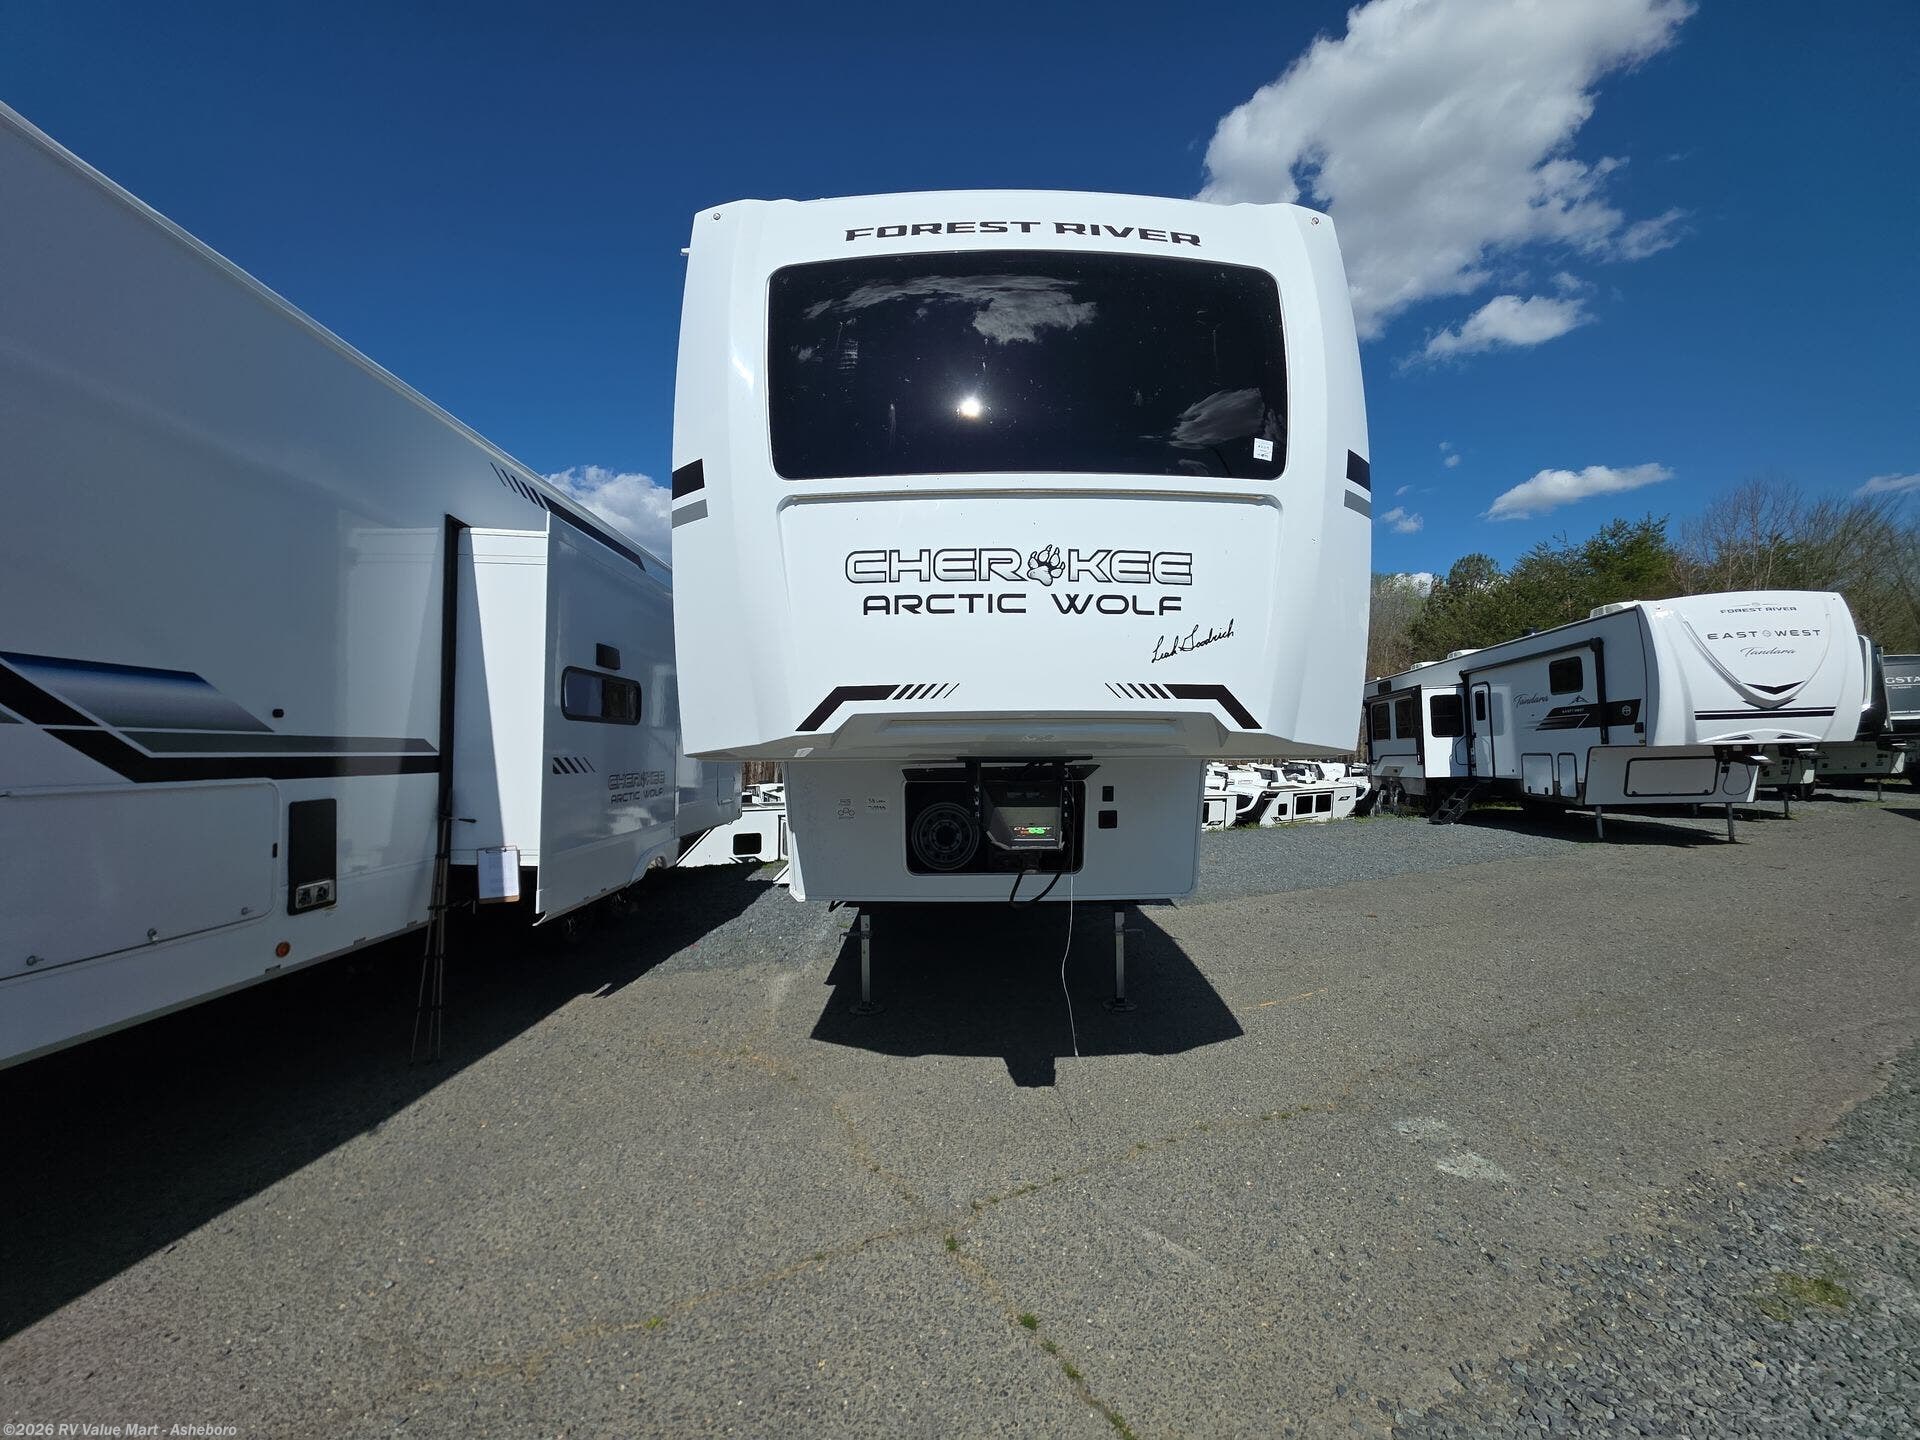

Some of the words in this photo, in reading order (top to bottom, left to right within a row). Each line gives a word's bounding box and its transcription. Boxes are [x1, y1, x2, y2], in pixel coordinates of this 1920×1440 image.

[846, 222, 1040, 241] FOREST
[1054, 223, 1200, 246] RIVER
[864, 594, 1026, 615] ARCTIC
[1051, 594, 1181, 615] WOLF
[1707, 631, 1757, 640] EAST
[1774, 629, 1821, 637] WEST
[1740, 646, 1796, 657] Tandara
